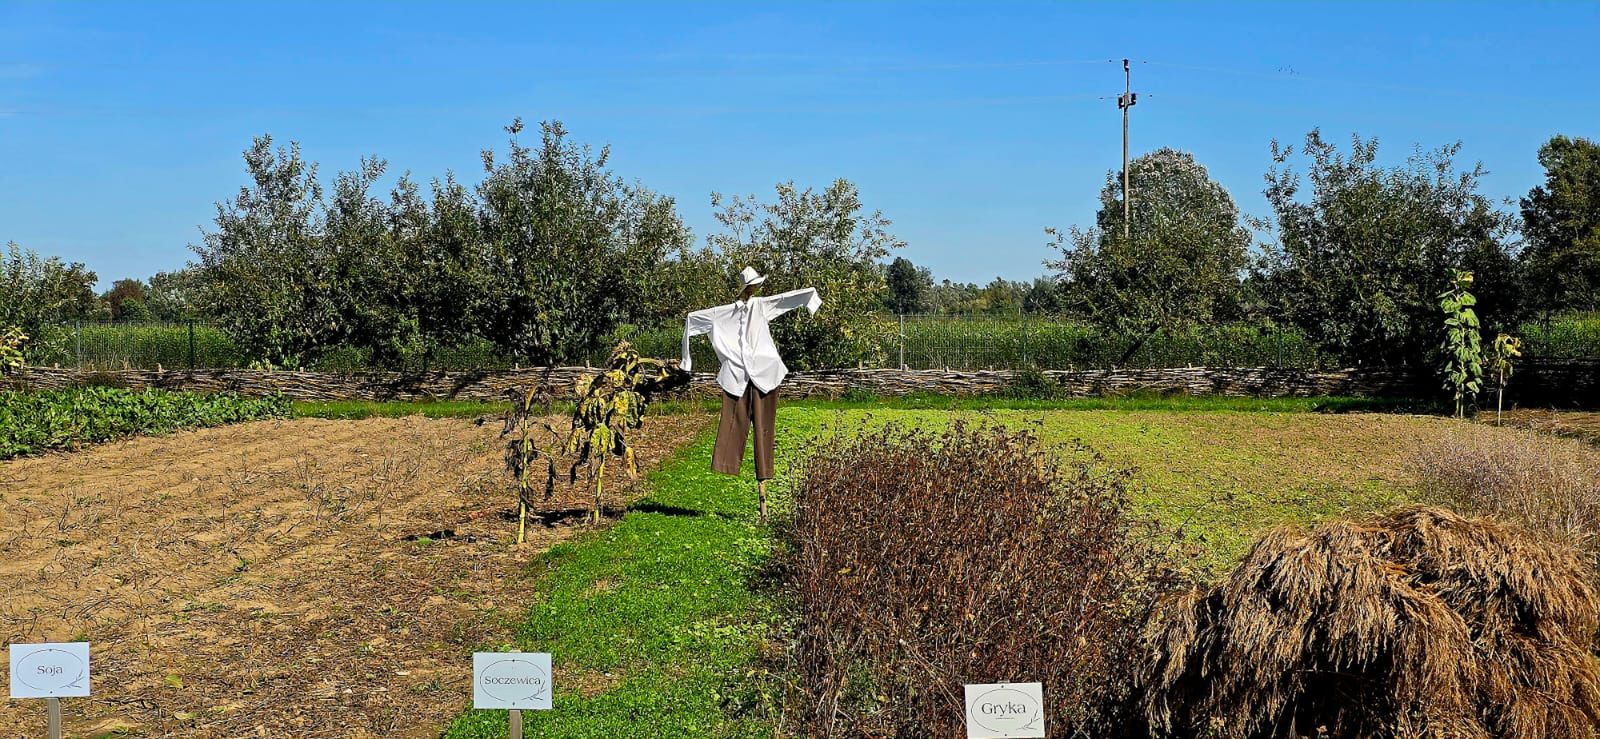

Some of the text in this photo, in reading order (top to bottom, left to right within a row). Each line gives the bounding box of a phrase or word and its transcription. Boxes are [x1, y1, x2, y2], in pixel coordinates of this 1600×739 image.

[37, 665, 63, 676] Soja
[484, 675, 541, 685] Soczewica
[981, 701, 1026, 716] Gryka
